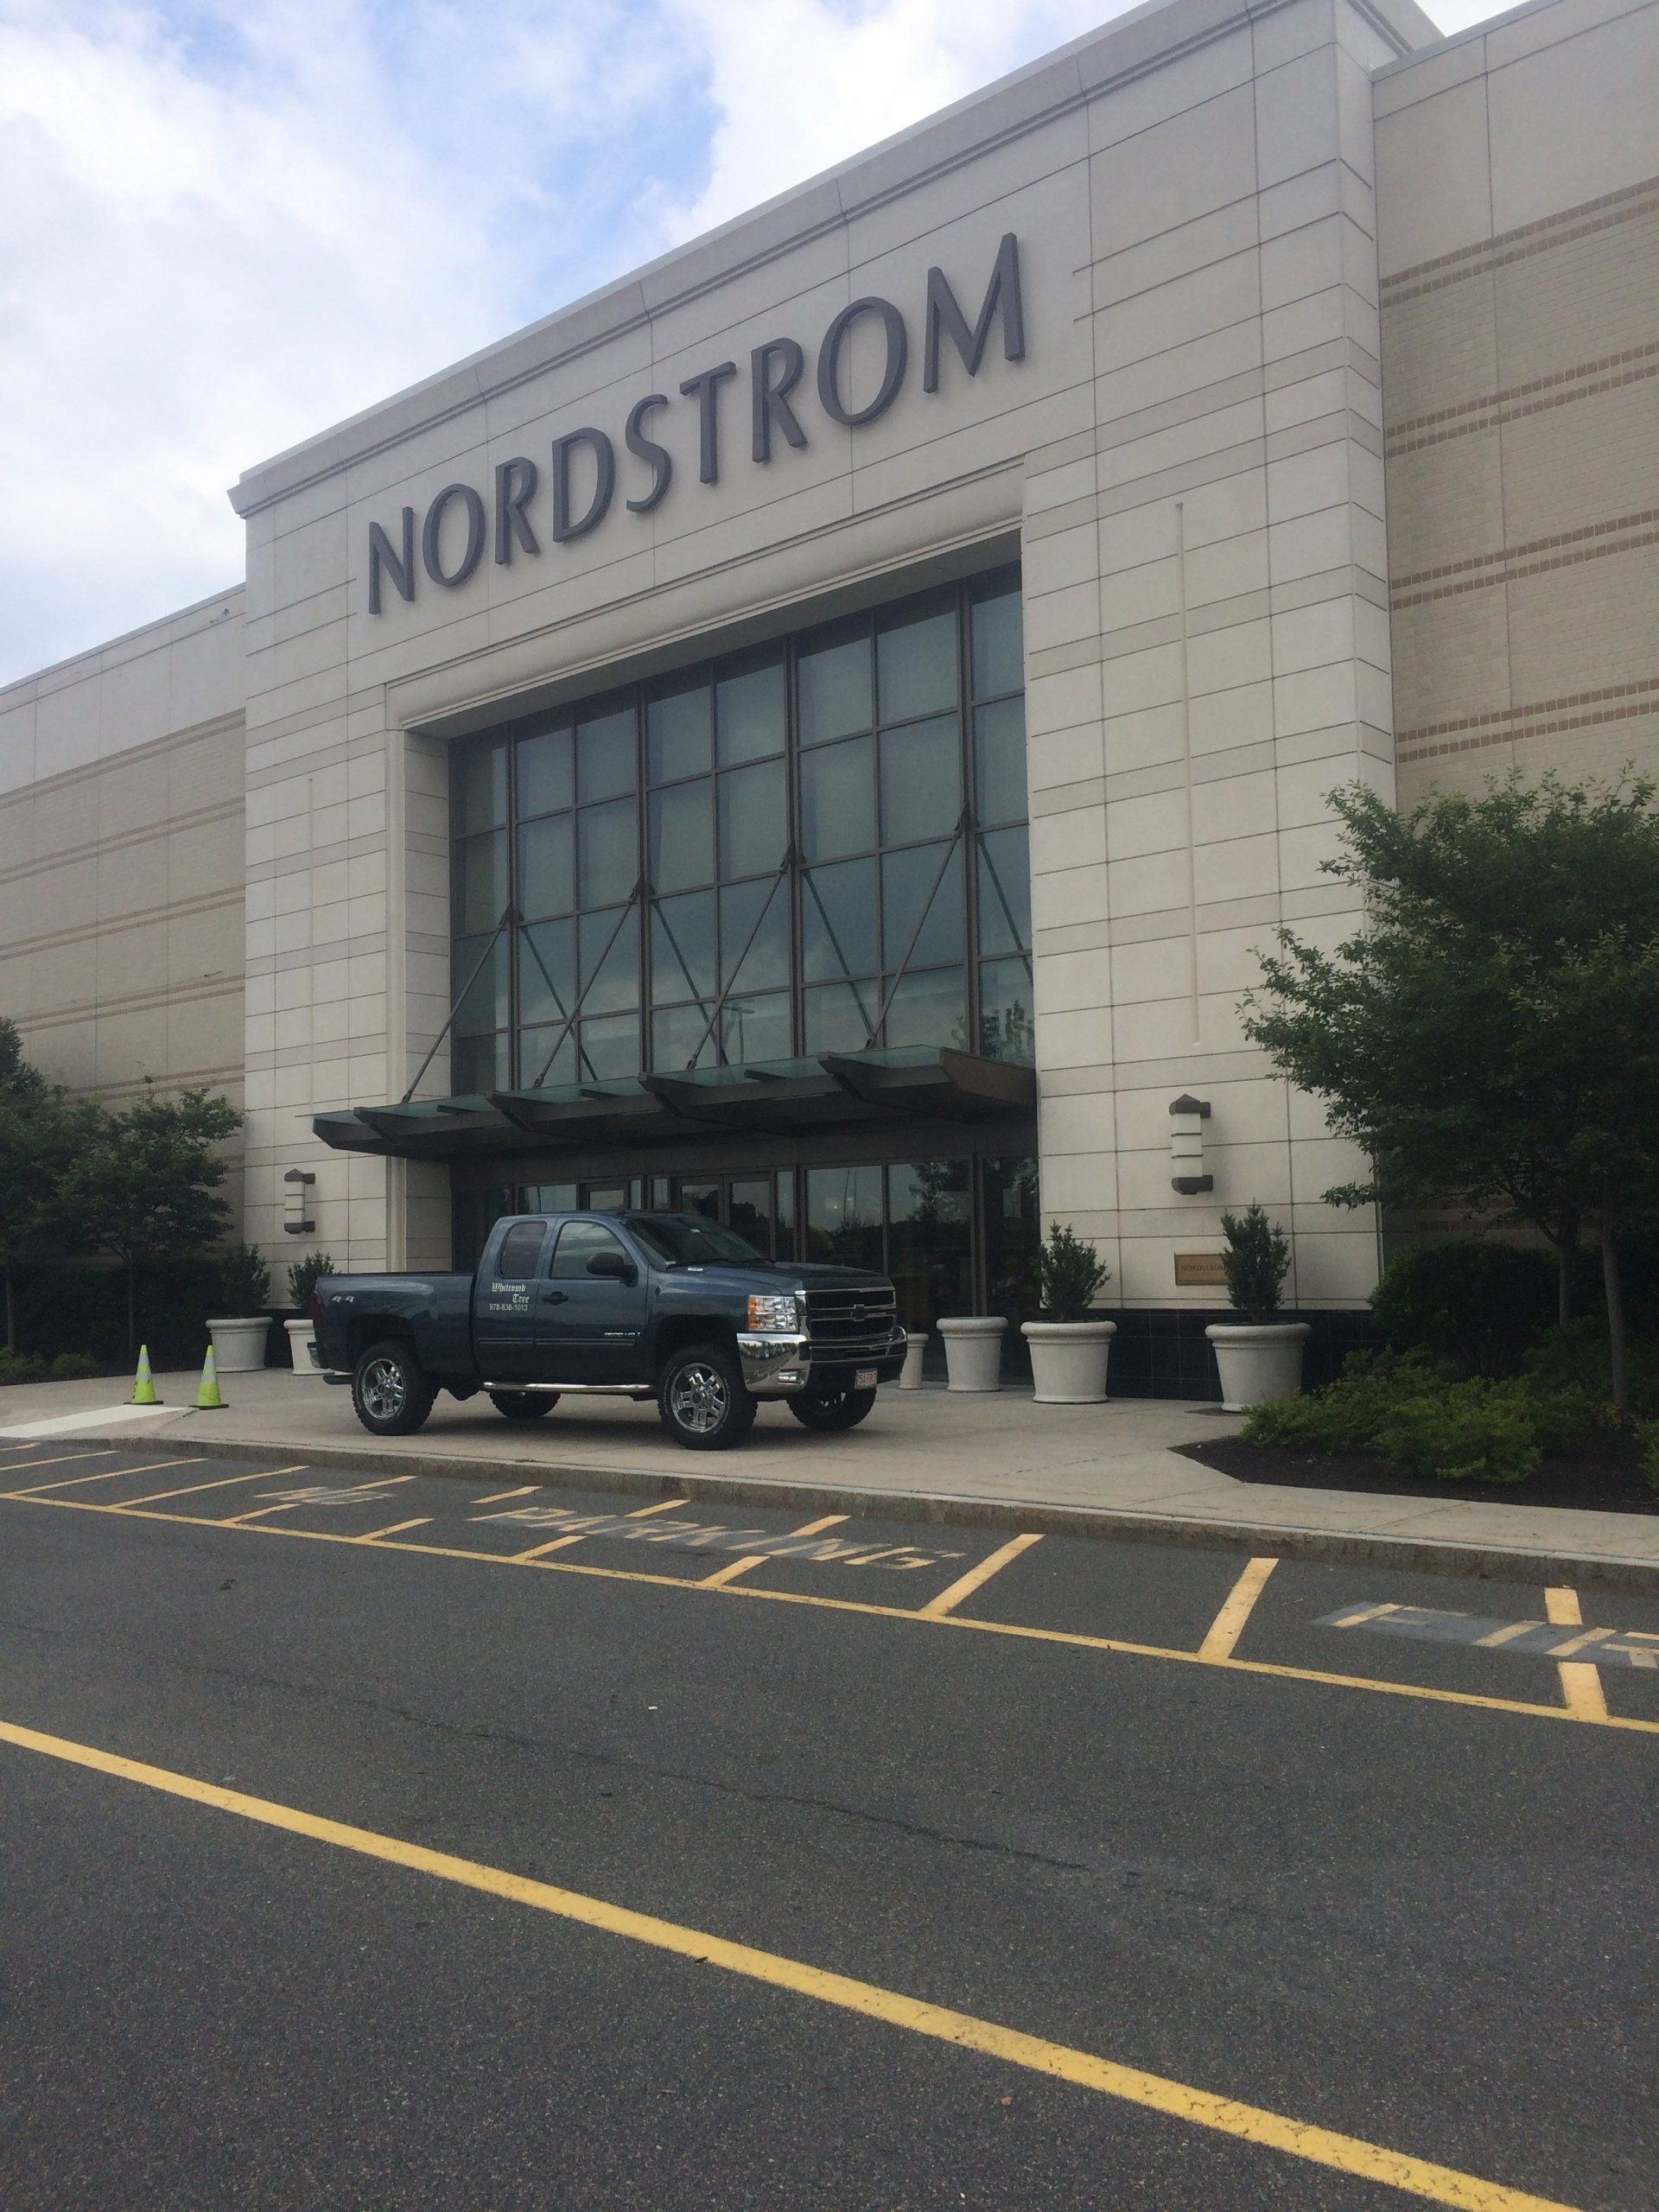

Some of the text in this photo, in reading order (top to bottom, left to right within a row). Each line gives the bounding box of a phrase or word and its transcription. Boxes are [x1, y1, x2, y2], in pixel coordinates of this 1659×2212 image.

[369, 232, 1027, 613] NORDSTROM
[491, 1282, 526, 1293] Whitcomb
[512, 1294, 530, 1303] Tree
[465, 1506, 965, 1570] PARKING
